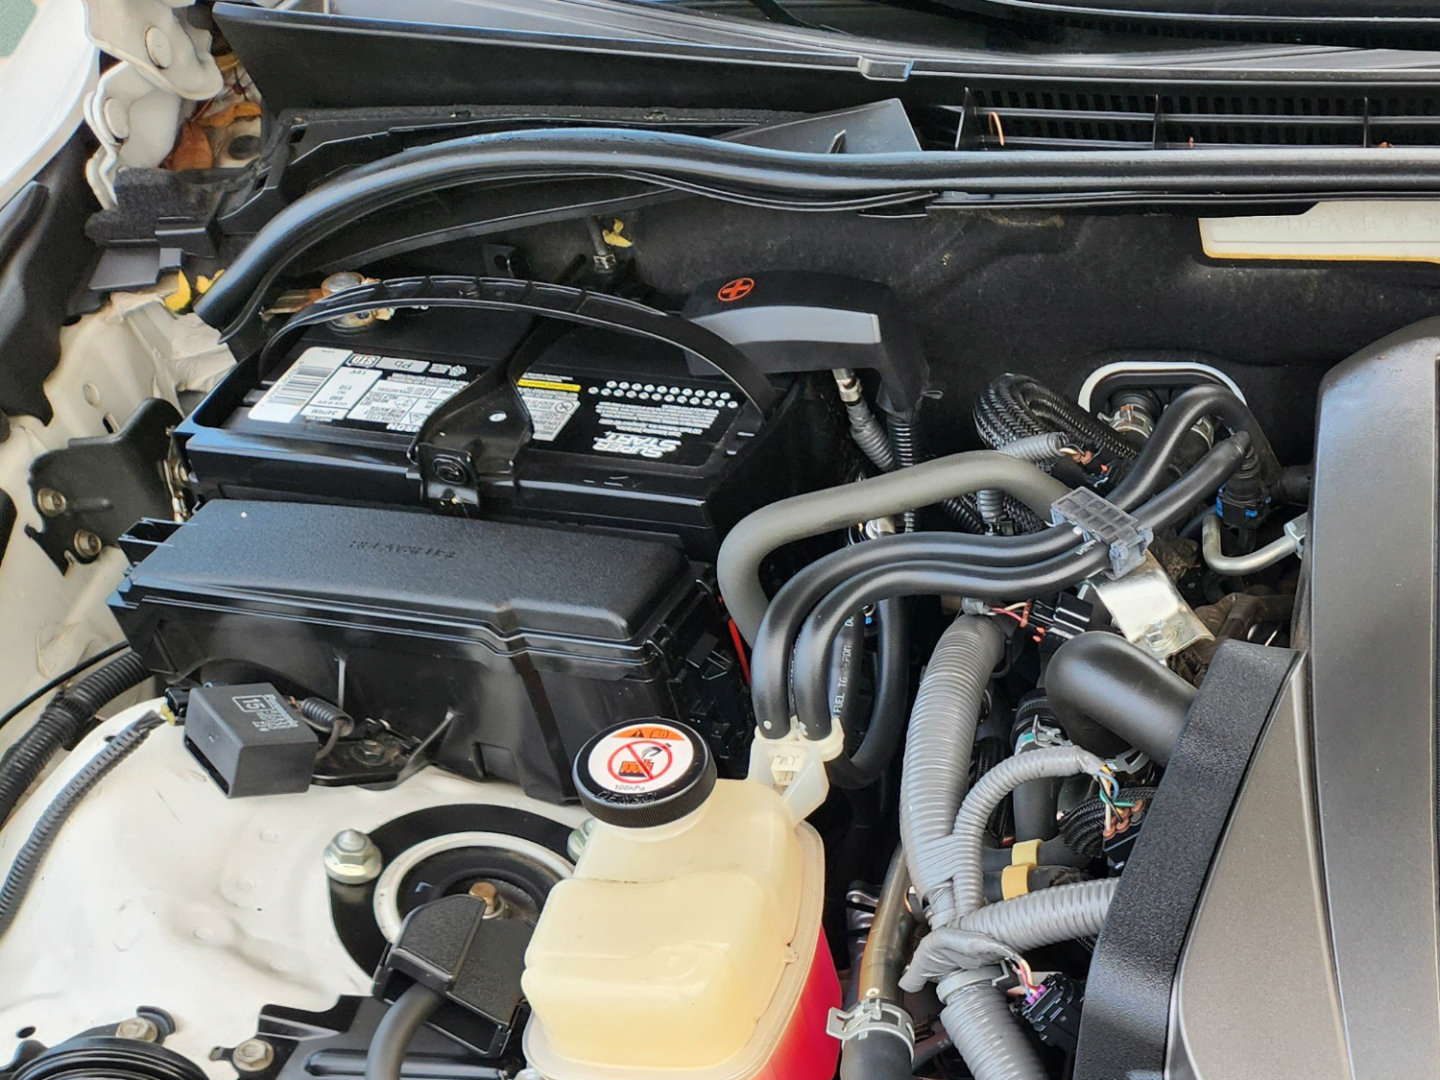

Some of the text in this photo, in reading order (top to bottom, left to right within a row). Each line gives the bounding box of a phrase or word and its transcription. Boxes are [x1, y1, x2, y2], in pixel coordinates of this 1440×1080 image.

[592, 439, 664, 459] SUPER
[242, 698, 266, 709] 15
[833, 692, 846, 713] FUEL
[595, 790, 657, 805] DENSO
